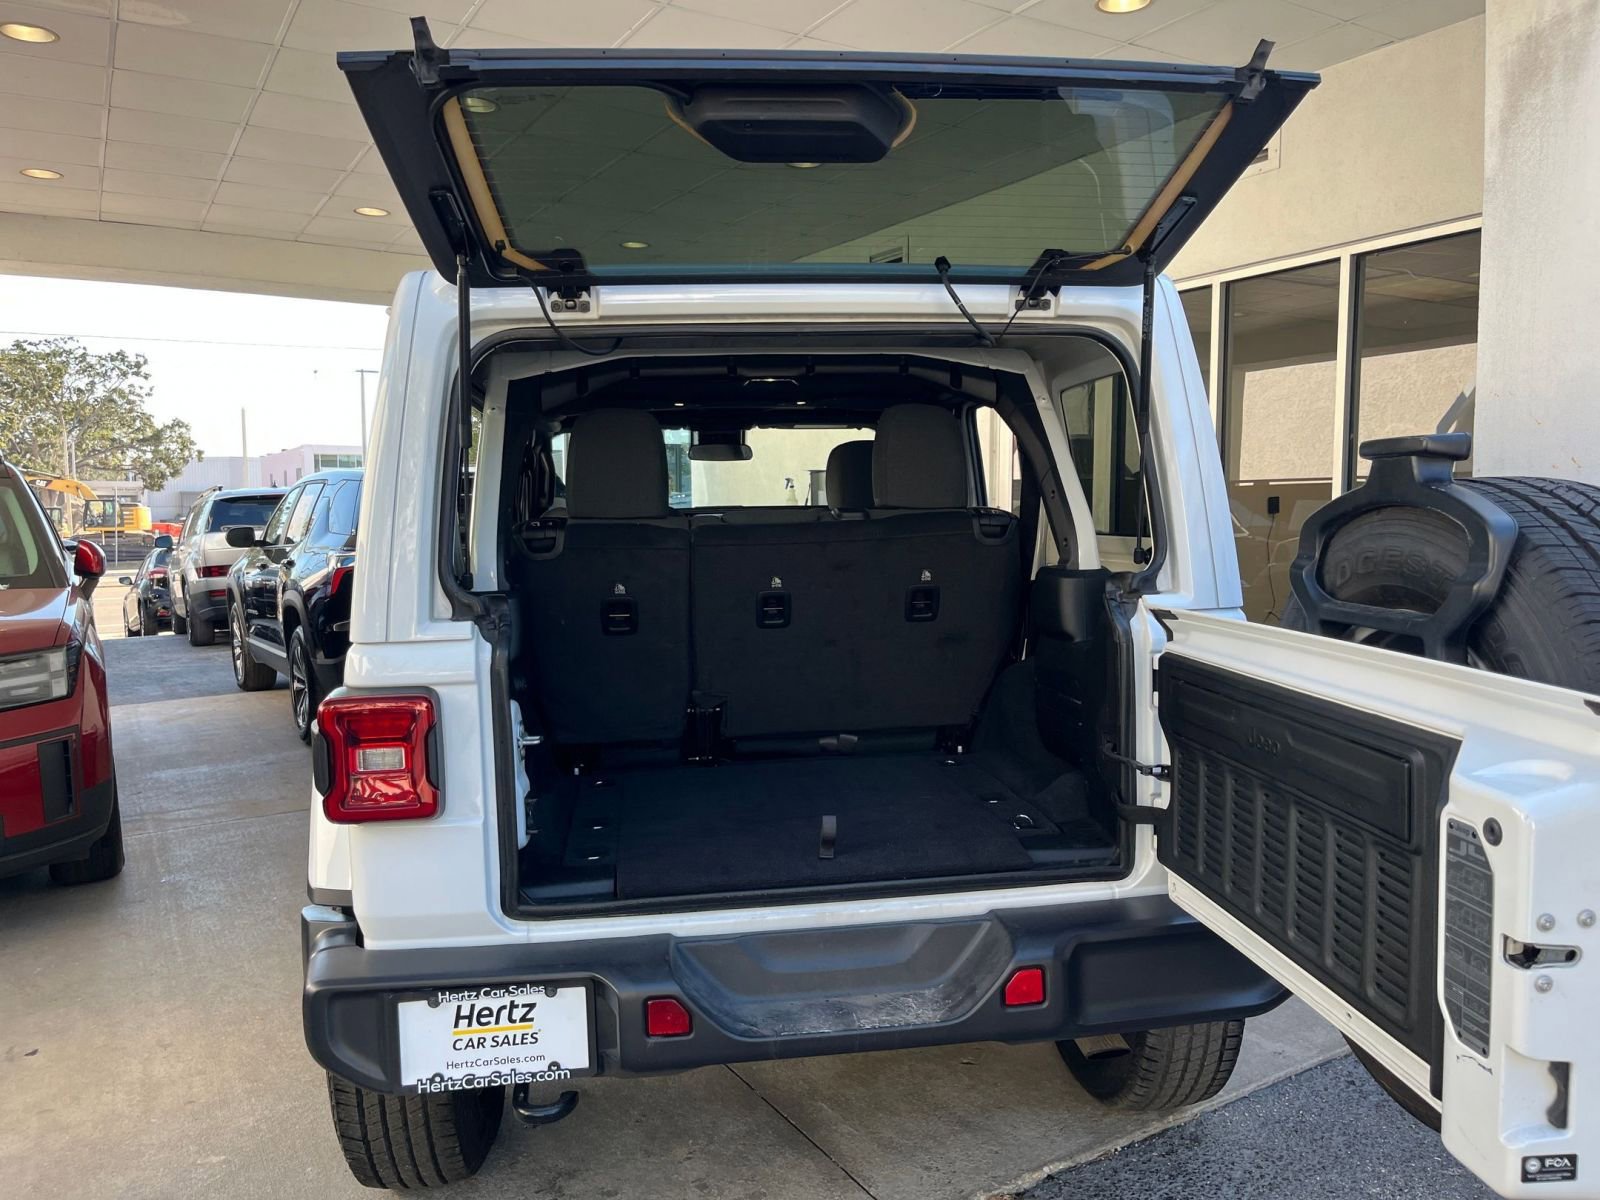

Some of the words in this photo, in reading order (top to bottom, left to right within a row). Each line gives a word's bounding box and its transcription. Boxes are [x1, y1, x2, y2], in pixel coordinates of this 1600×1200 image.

[437, 991, 478, 1003] Hertz
[480, 987, 506, 998] Car
[508, 983, 545, 996] Sales
[453, 1000, 537, 1029] Hertz
[452, 1037, 487, 1051] CAR
[490, 1032, 539, 1048] SALES
[446, 1053, 546, 1070] HertzCarSales.com
[417, 1069, 571, 1094] HertzCarSales.com
[1544, 1157, 1572, 1168] FCA
